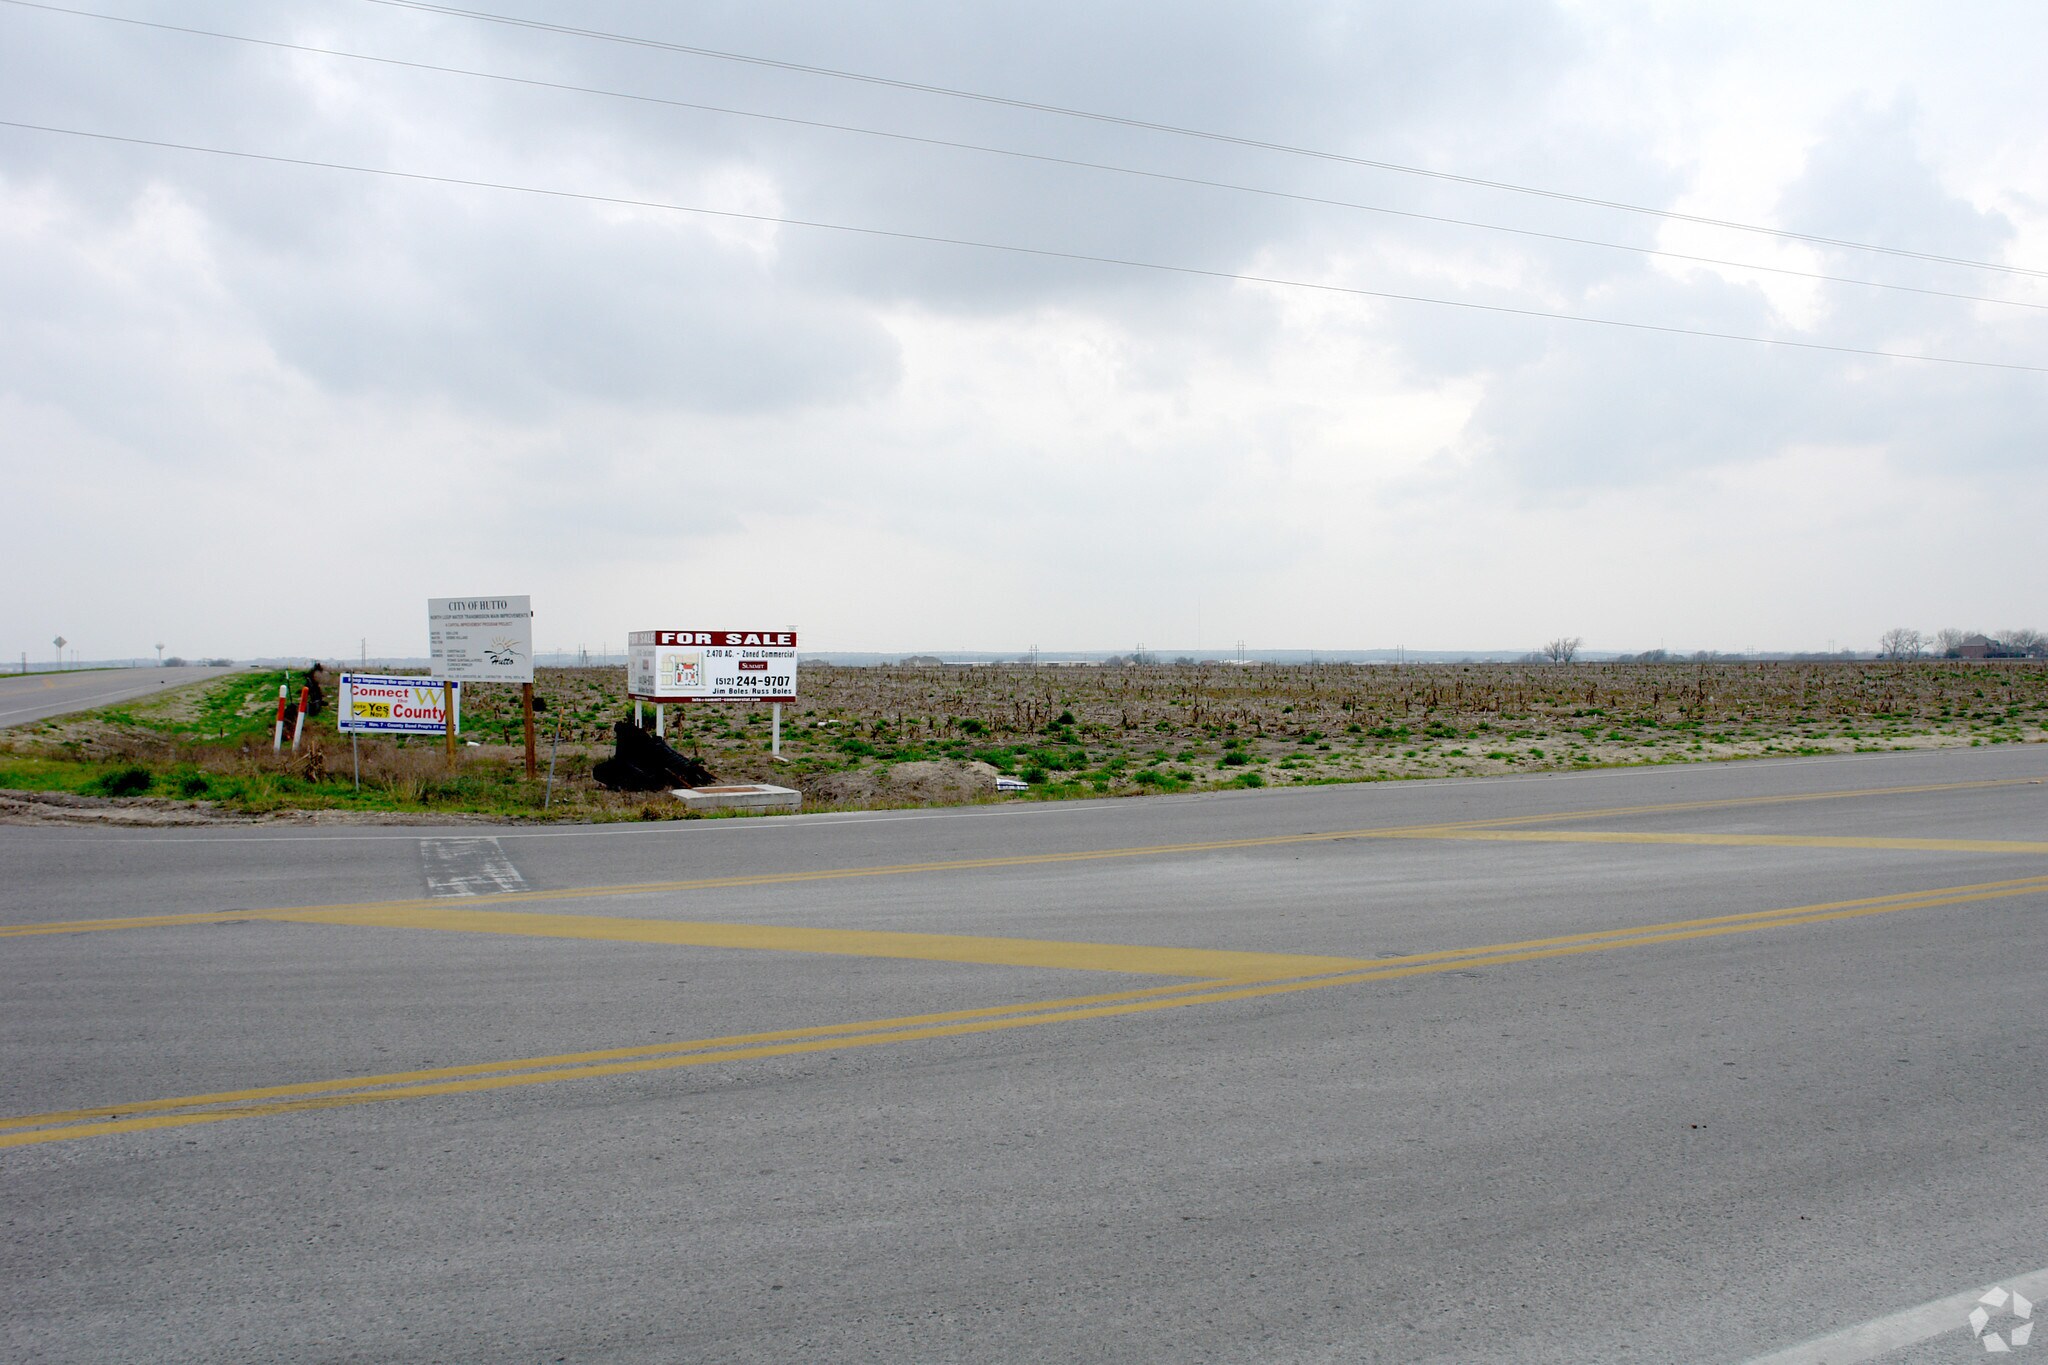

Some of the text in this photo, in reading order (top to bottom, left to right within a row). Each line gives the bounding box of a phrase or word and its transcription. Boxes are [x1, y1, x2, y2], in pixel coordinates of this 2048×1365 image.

[448, 600, 508, 611] CITY OF HUTTO
[661, 632, 792, 645] FOR SALE
[706, 650, 723, 658] 2.470
[724, 650, 734, 658] AC.
[490, 655, 514, 666] Hutto
[715, 676, 790, 686] (512) 244-9707
[352, 686, 445, 706] Connect W
[368, 703, 389, 712] Yes
[393, 704, 446, 722] County
